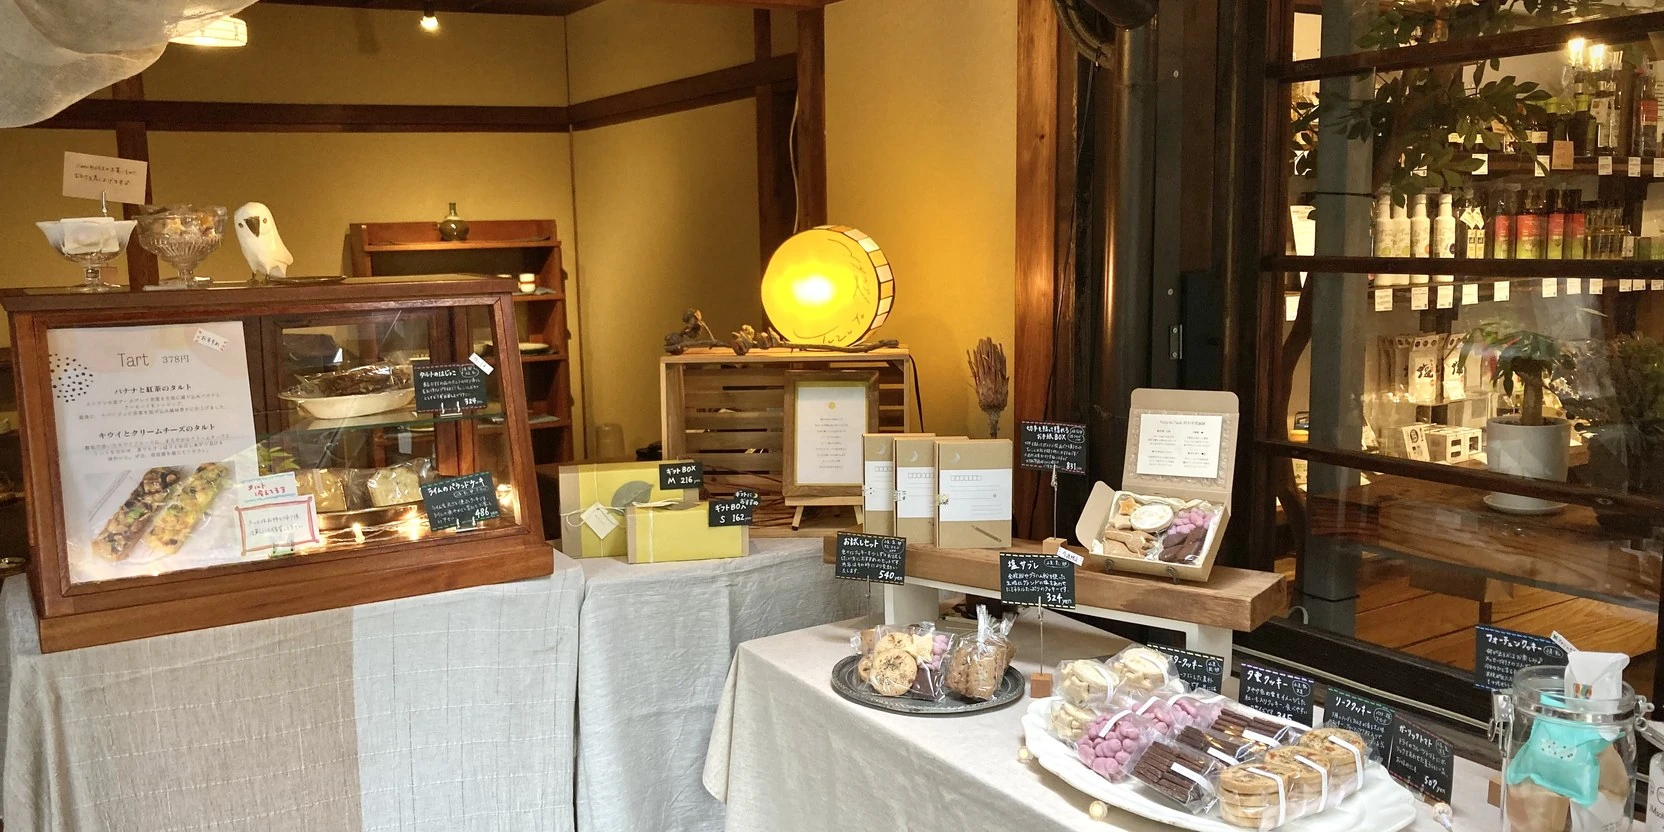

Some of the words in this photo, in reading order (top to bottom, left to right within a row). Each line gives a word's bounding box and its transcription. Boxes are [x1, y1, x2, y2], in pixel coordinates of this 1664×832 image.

[118, 353, 149, 368] Tart
[162, 354, 190, 364] 378円
[114, 383, 192, 394] バナナと紅茶のタルト
[98, 423, 216, 440] キウイとクリームチーズのタルト
[427, 476, 485, 497] ライムのパウンドケーキ
[667, 477, 676, 485] M
[719, 515, 726, 524] S
[843, 537, 879, 548] お試しセット
[1485, 633, 1542, 653] フォーチュンクッキー
[1335, 696, 1372, 716] リーフクッキー
[1399, 724, 1433, 748] ガーリックトマト
